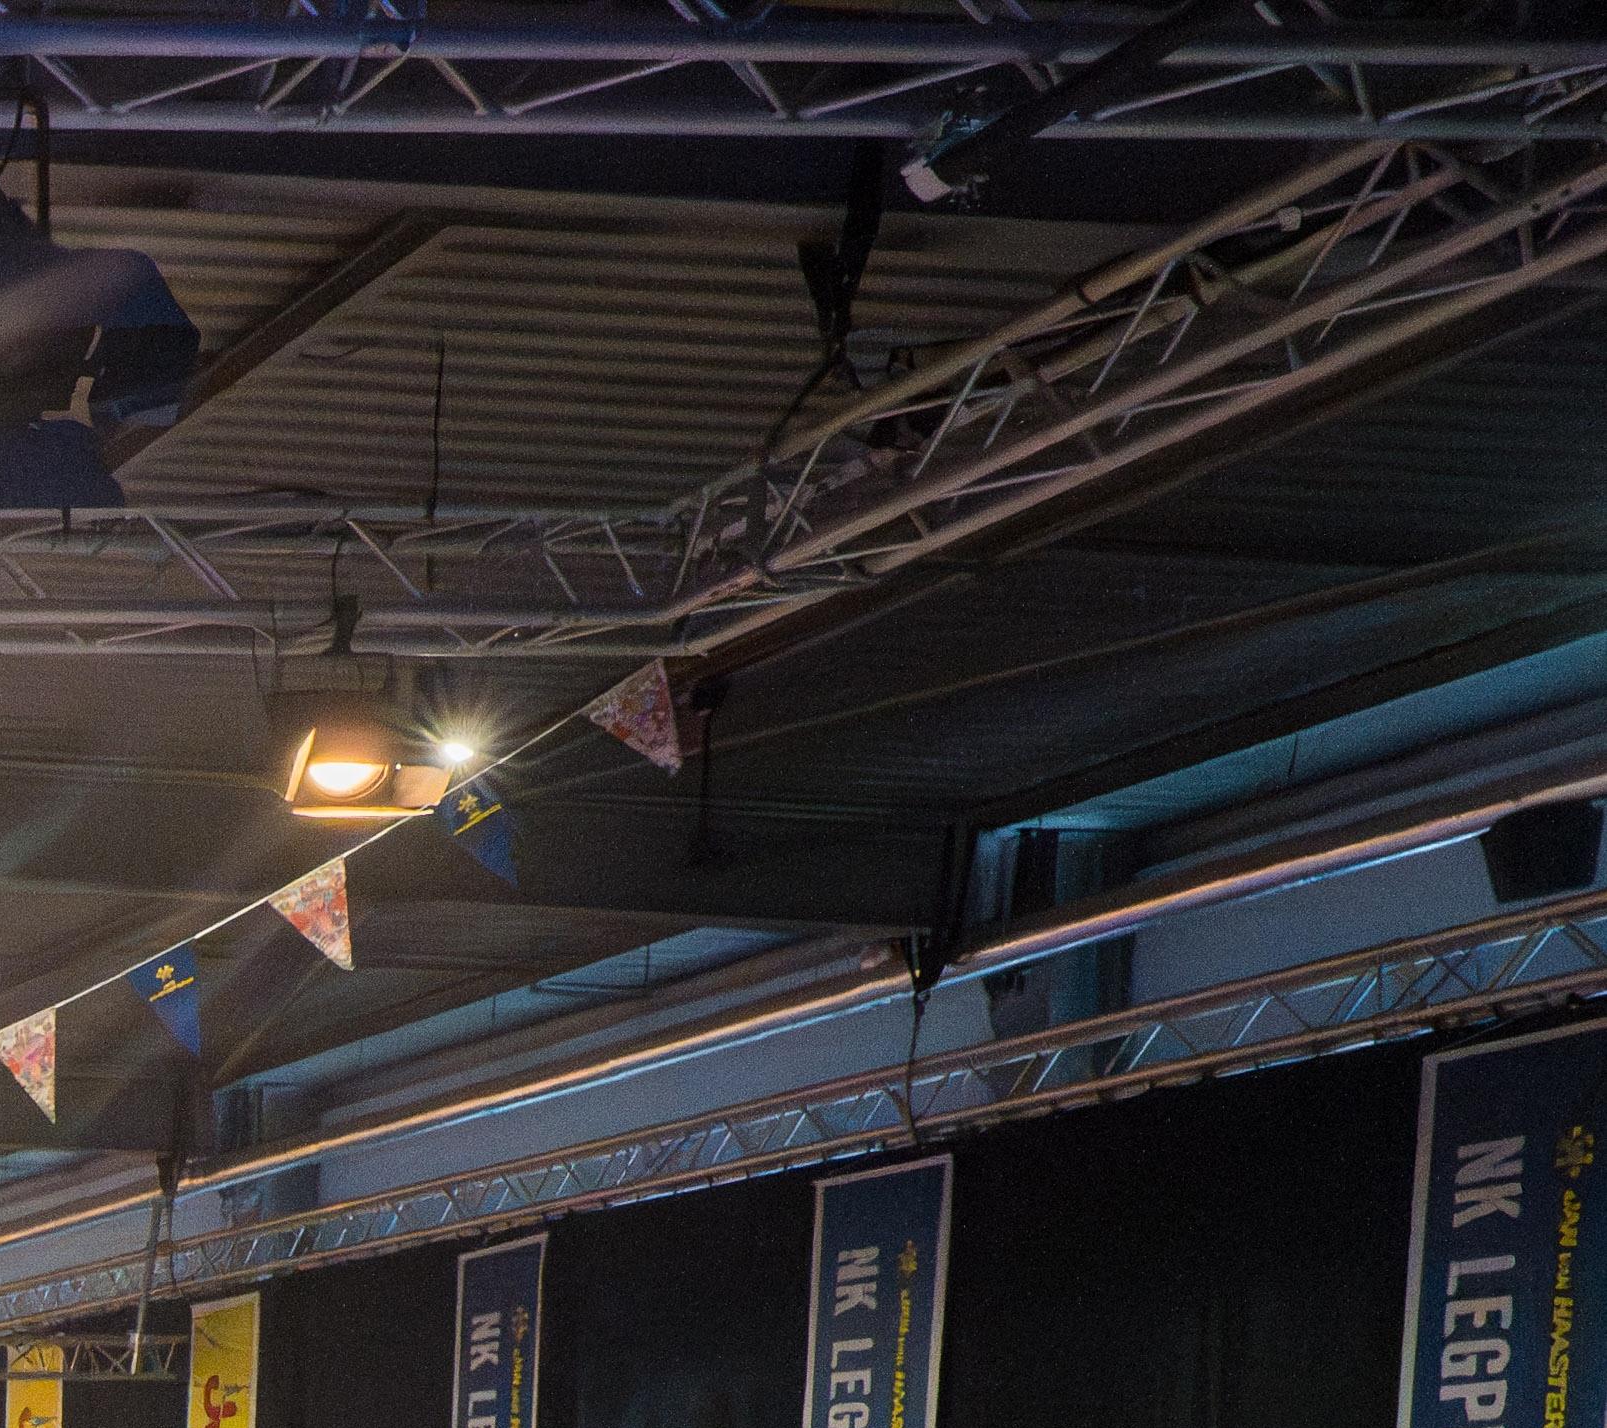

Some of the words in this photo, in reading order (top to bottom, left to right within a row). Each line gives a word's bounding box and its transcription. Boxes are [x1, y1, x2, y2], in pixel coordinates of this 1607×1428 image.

[1453, 1135, 1527, 1218] NK
[1559, 1189, 1577, 1249] JAN
[834, 1248, 879, 1316] NK
[470, 1312, 499, 1371] NK
